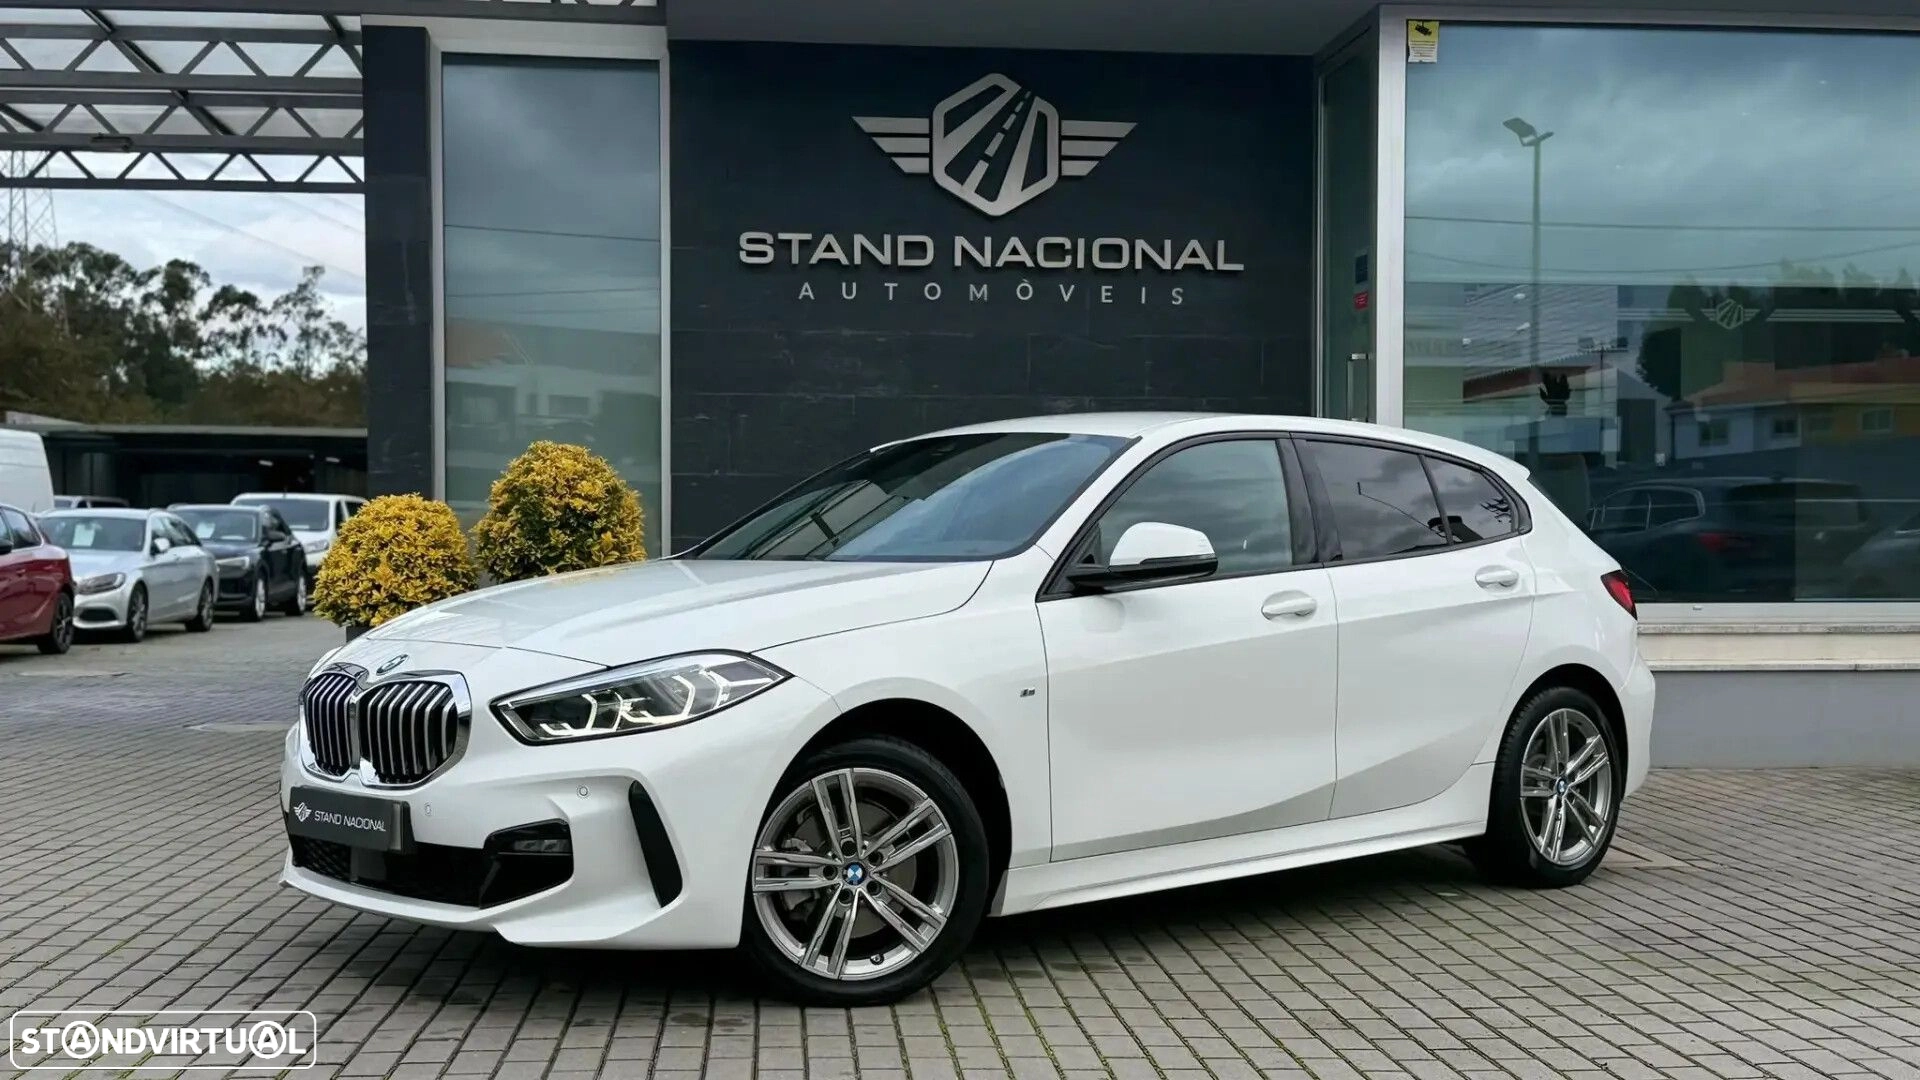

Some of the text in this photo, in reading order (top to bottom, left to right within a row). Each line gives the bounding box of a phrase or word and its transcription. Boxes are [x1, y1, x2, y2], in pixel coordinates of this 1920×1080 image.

[739, 231, 1245, 271] STAND NACIONAL
[798, 278, 1184, 305] AUTOMÒVEIS
[314, 810, 387, 832] STAND NACIONAL
